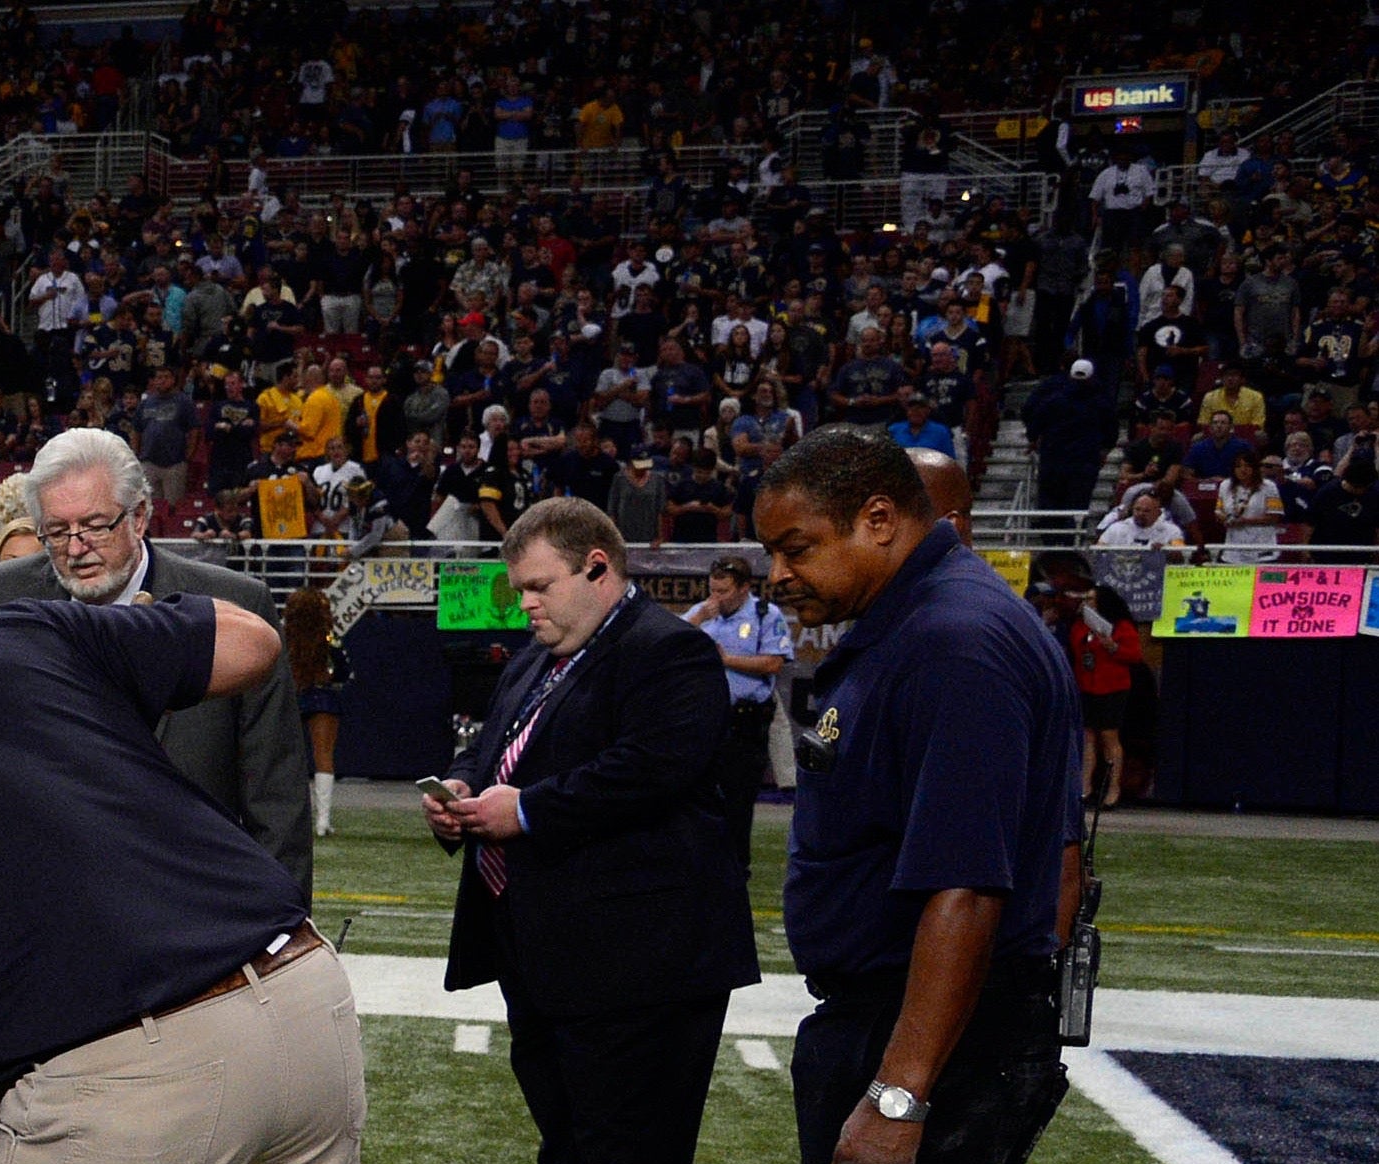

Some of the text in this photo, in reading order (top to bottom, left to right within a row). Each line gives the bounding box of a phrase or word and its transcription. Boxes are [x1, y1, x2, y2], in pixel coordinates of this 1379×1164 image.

[373, 562, 428, 579] RAMS
[1258, 591, 1352, 610] CONSIDER
[1262, 619, 1337, 634] IT DONE
